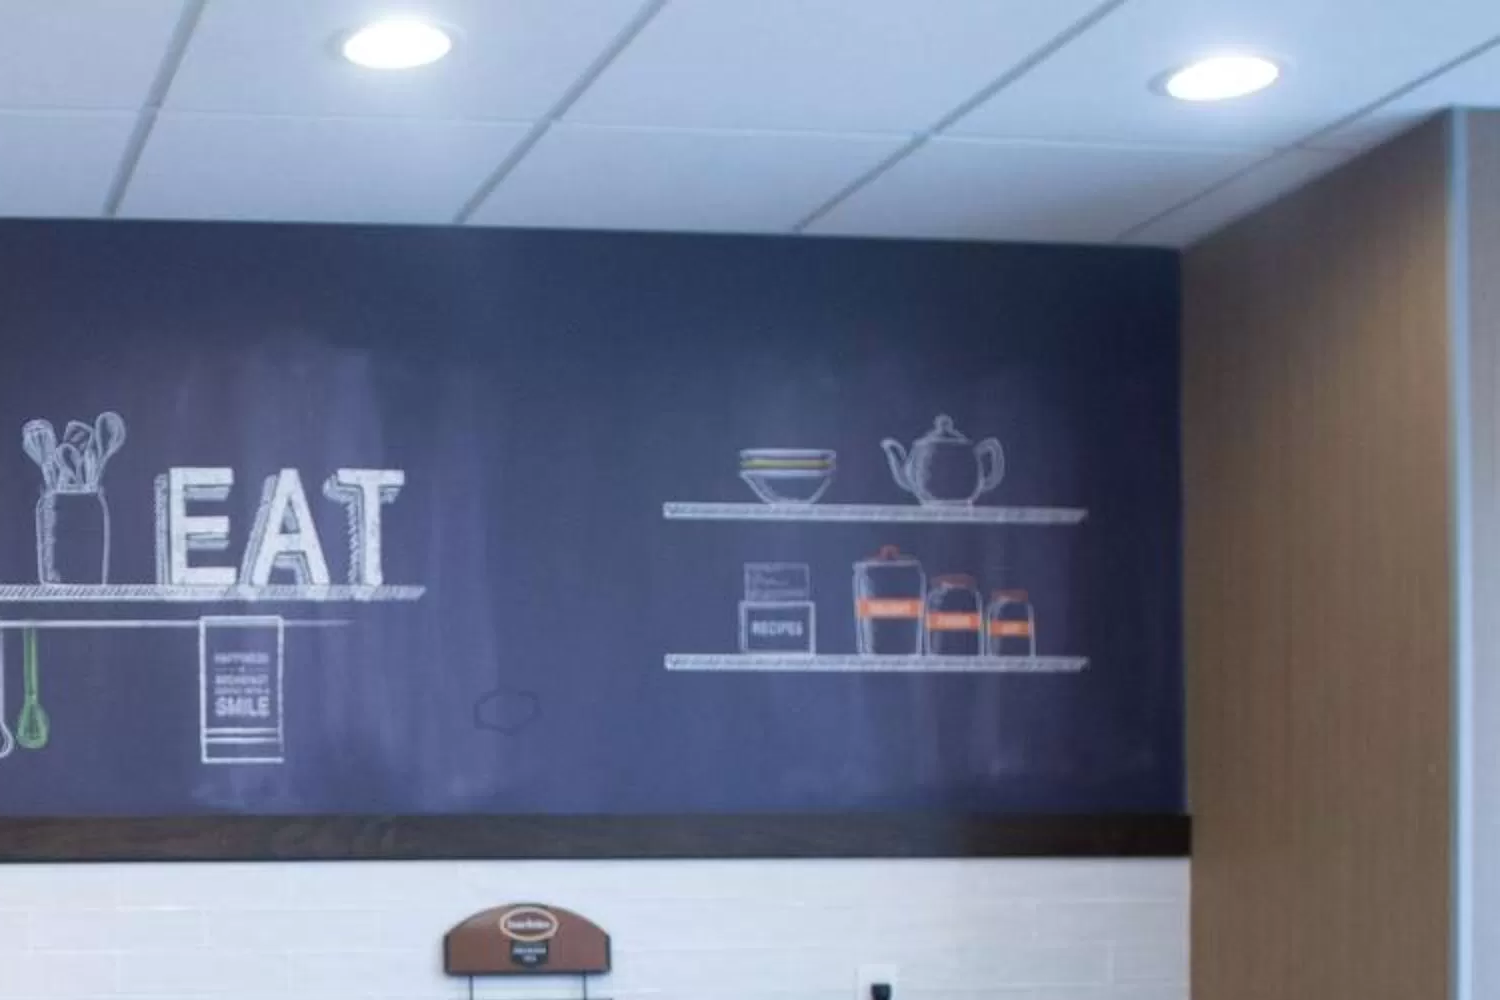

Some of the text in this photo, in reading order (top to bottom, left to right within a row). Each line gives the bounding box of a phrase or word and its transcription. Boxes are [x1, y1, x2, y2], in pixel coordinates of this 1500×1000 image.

[155, 467, 405, 594] EAT
[752, 620, 804, 636] RECIPES
[214, 696, 270, 717] SMILE
